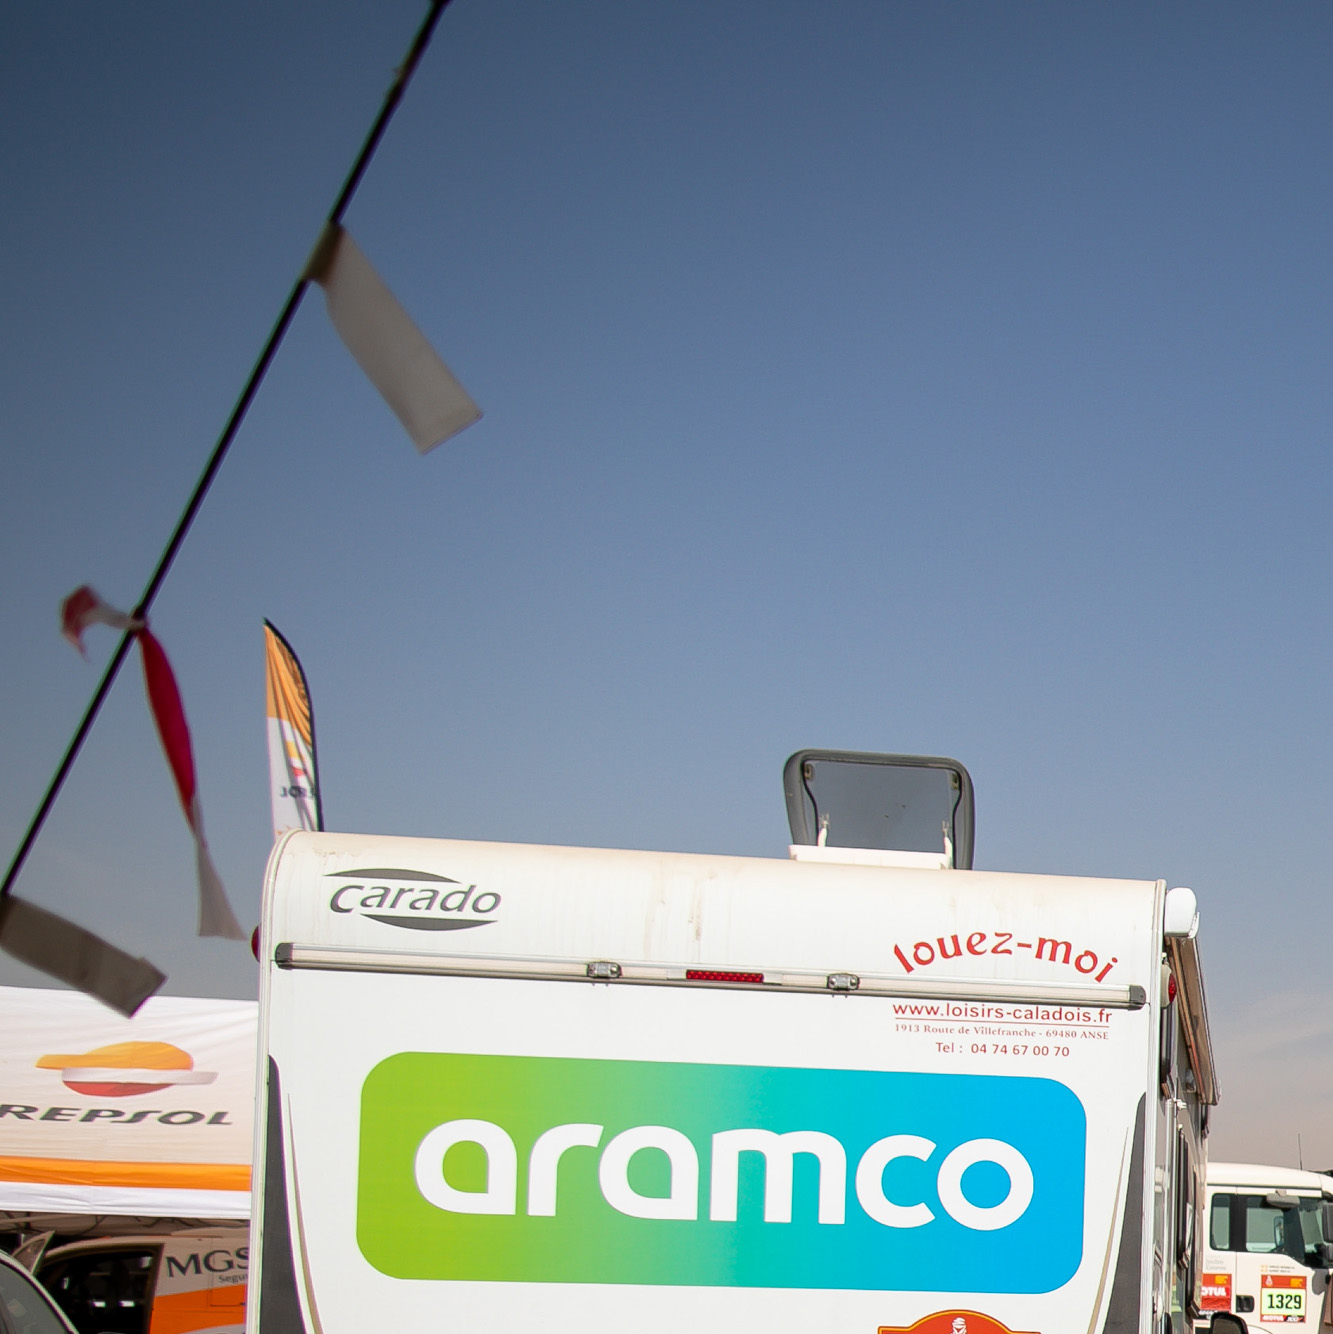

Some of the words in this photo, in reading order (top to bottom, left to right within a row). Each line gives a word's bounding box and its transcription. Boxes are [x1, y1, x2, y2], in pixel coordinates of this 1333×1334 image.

[330, 884, 502, 914] carado
[893, 931, 1119, 983] louez-moi
[893, 1003, 1113, 1023] www.loisirs-caladois.fr
[895, 1024, 920, 1033] 1913
[923, 1025, 955, 1034] Route
[958, 1026, 970, 1034] de
[974, 1026, 1036, 1037] Villefranche
[1045, 1030, 1077, 1039] 69480
[1080, 1031, 1109, 1040] ANSE
[936, 1042, 955, 1053] Tel
[971, 1043, 987, 1054] 04
[992, 1044, 1008, 1055] 74
[1012, 1044, 1028, 1055] 67
[1032, 1045, 1049, 1056] 00
[1053, 1046, 1070, 1057] 70
[0, 1104, 233, 1125] REPSOL
[414, 1119, 1034, 1231] aramco
[1201, 1286, 1227, 1297] OTUL
[1267, 1294, 1302, 1309] 1329
